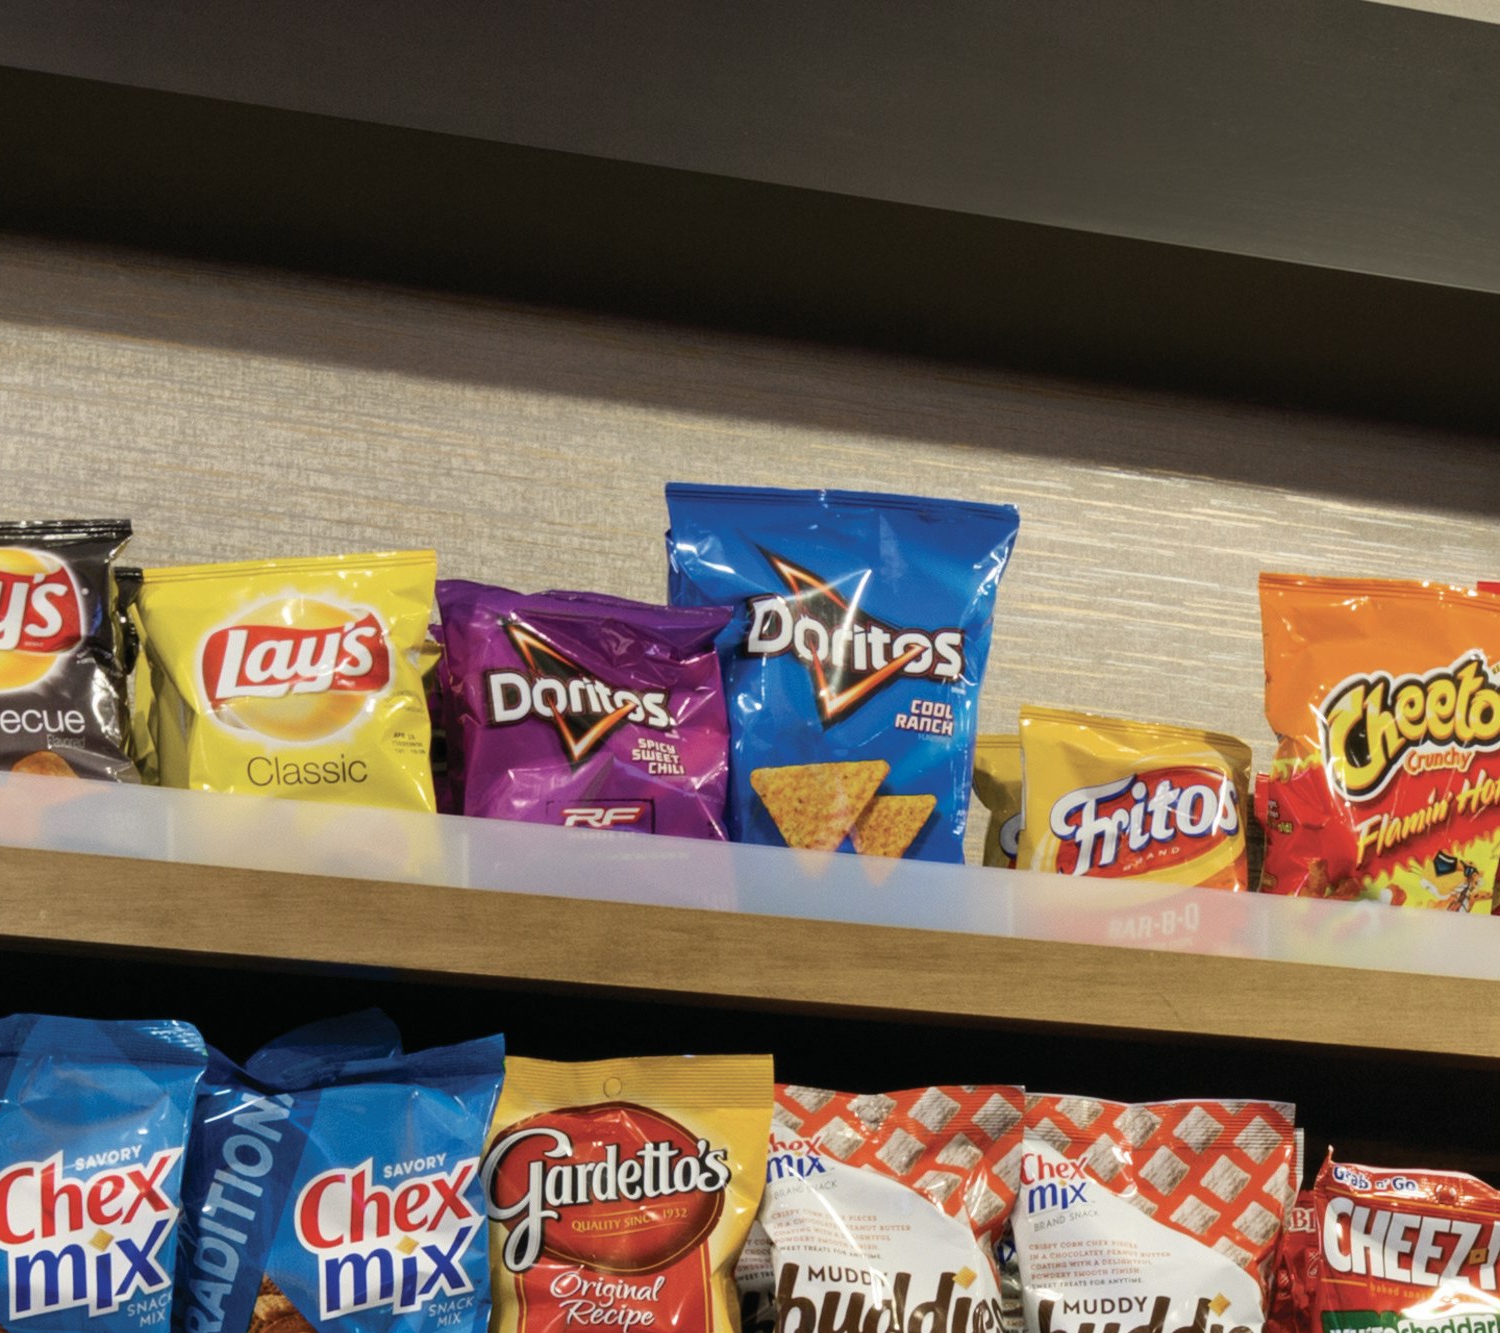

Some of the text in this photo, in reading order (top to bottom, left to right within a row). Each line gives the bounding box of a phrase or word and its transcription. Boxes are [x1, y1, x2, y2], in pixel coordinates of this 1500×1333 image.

[747, 597, 963, 678] Doritos
[215, 622, 375, 698] Lay's
[489, 672, 672, 728] Doritos
[911, 699, 954, 719] COOL
[895, 713, 954, 736] RANCH
[632, 749, 679, 764] SWEET
[638, 738, 676, 753] SPICY
[246, 754, 368, 787] Classic
[648, 762, 685, 775] CHILI
[1405, 749, 1473, 774] Crunchy
[1049, 774, 1238, 876] Fritos
[74, 1144, 143, 1171] SAVORY
[383, 1153, 446, 1179] SAVORY
[1020, 1152, 1087, 1184] Chex
[299, 1164, 474, 1249] Chex
[482, 1128, 729, 1271] Gardetto's
[572, 1207, 688, 1232] QUALITY 1932
[1034, 1216, 1066, 1232] BRAND
[550, 1271, 664, 1308] Original
[428, 1296, 474, 1319] SNACK
[1063, 1296, 1148, 1314] MUDDY
[139, 1310, 166, 1327] MIX
[436, 1312, 462, 1328] MIX
